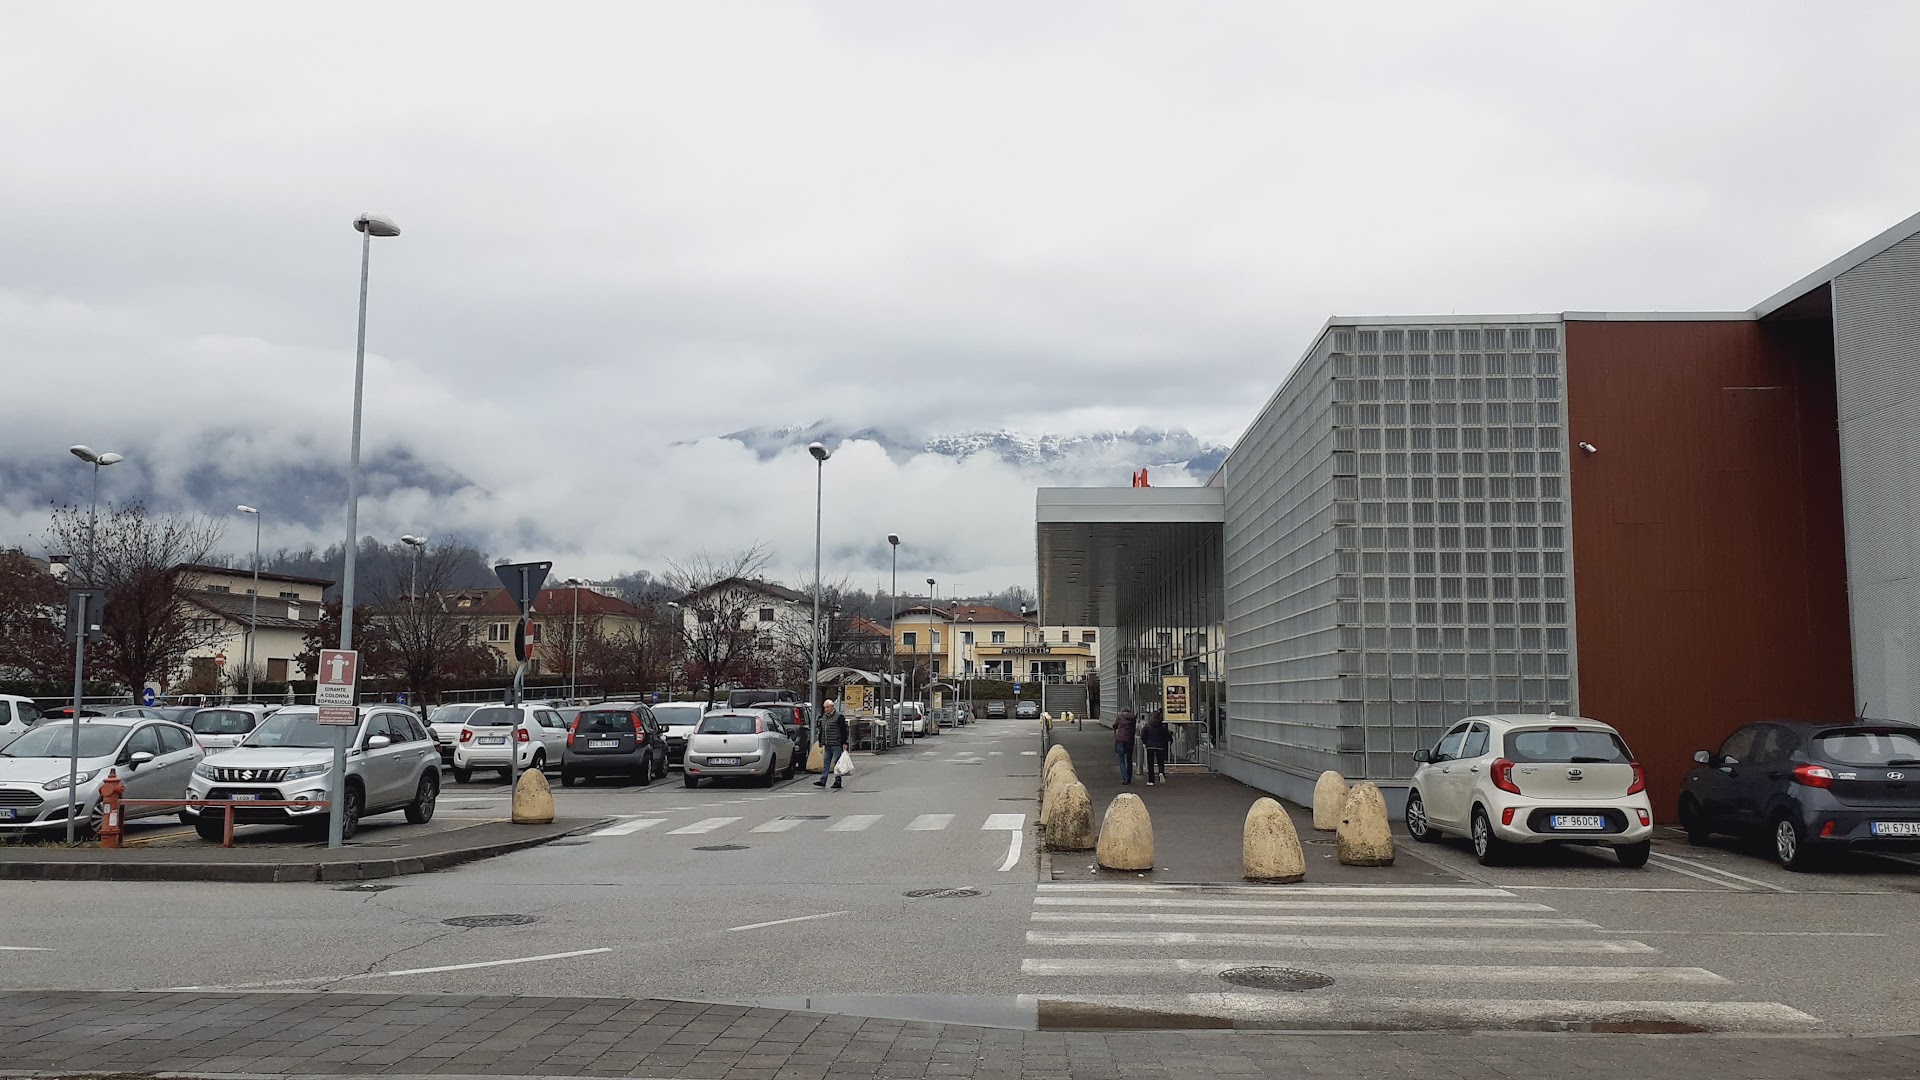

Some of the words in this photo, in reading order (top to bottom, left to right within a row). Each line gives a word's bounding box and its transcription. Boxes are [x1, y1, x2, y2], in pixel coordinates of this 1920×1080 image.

[1556, 816, 1567, 825] GF
[1570, 816, 1599, 825] 960CR
[1878, 823, 1890, 832] GH
